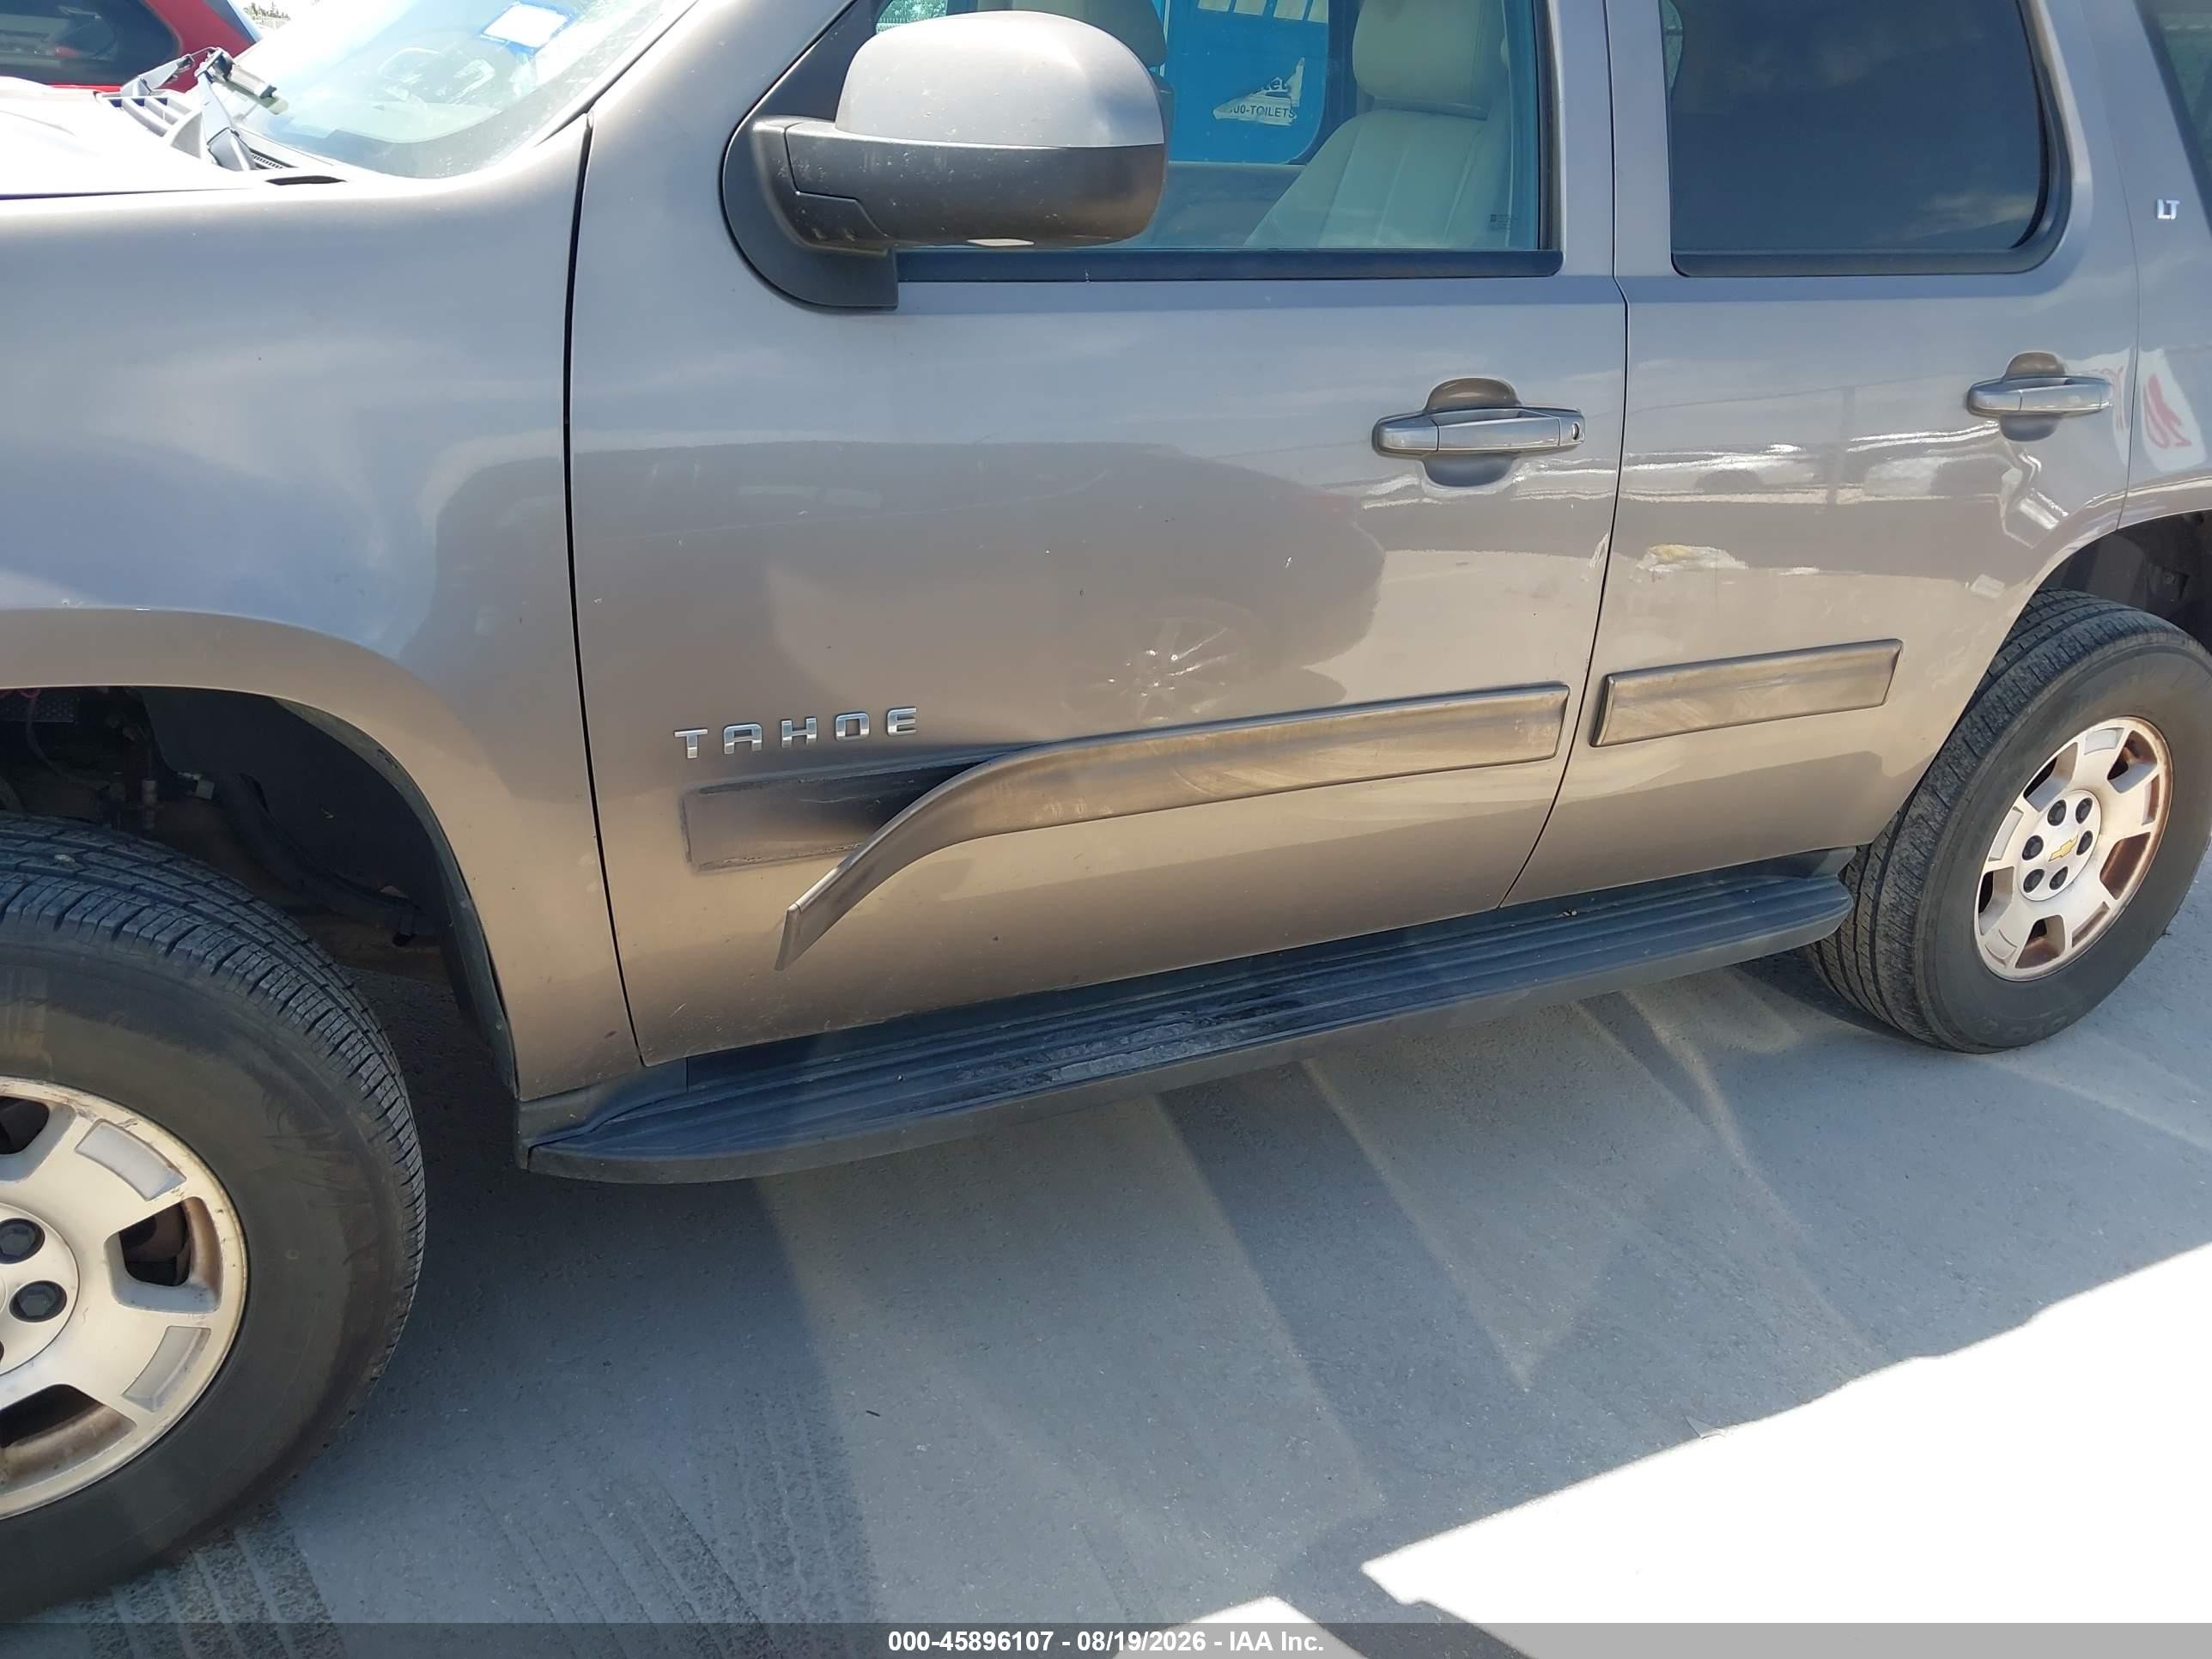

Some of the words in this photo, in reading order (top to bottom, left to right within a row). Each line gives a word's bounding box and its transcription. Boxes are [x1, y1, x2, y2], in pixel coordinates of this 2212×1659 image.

[1229, 104, 1295, 118] 00-TOILETS
[2156, 198, 2180, 220] LT
[673, 706, 918, 759] TAHOE
